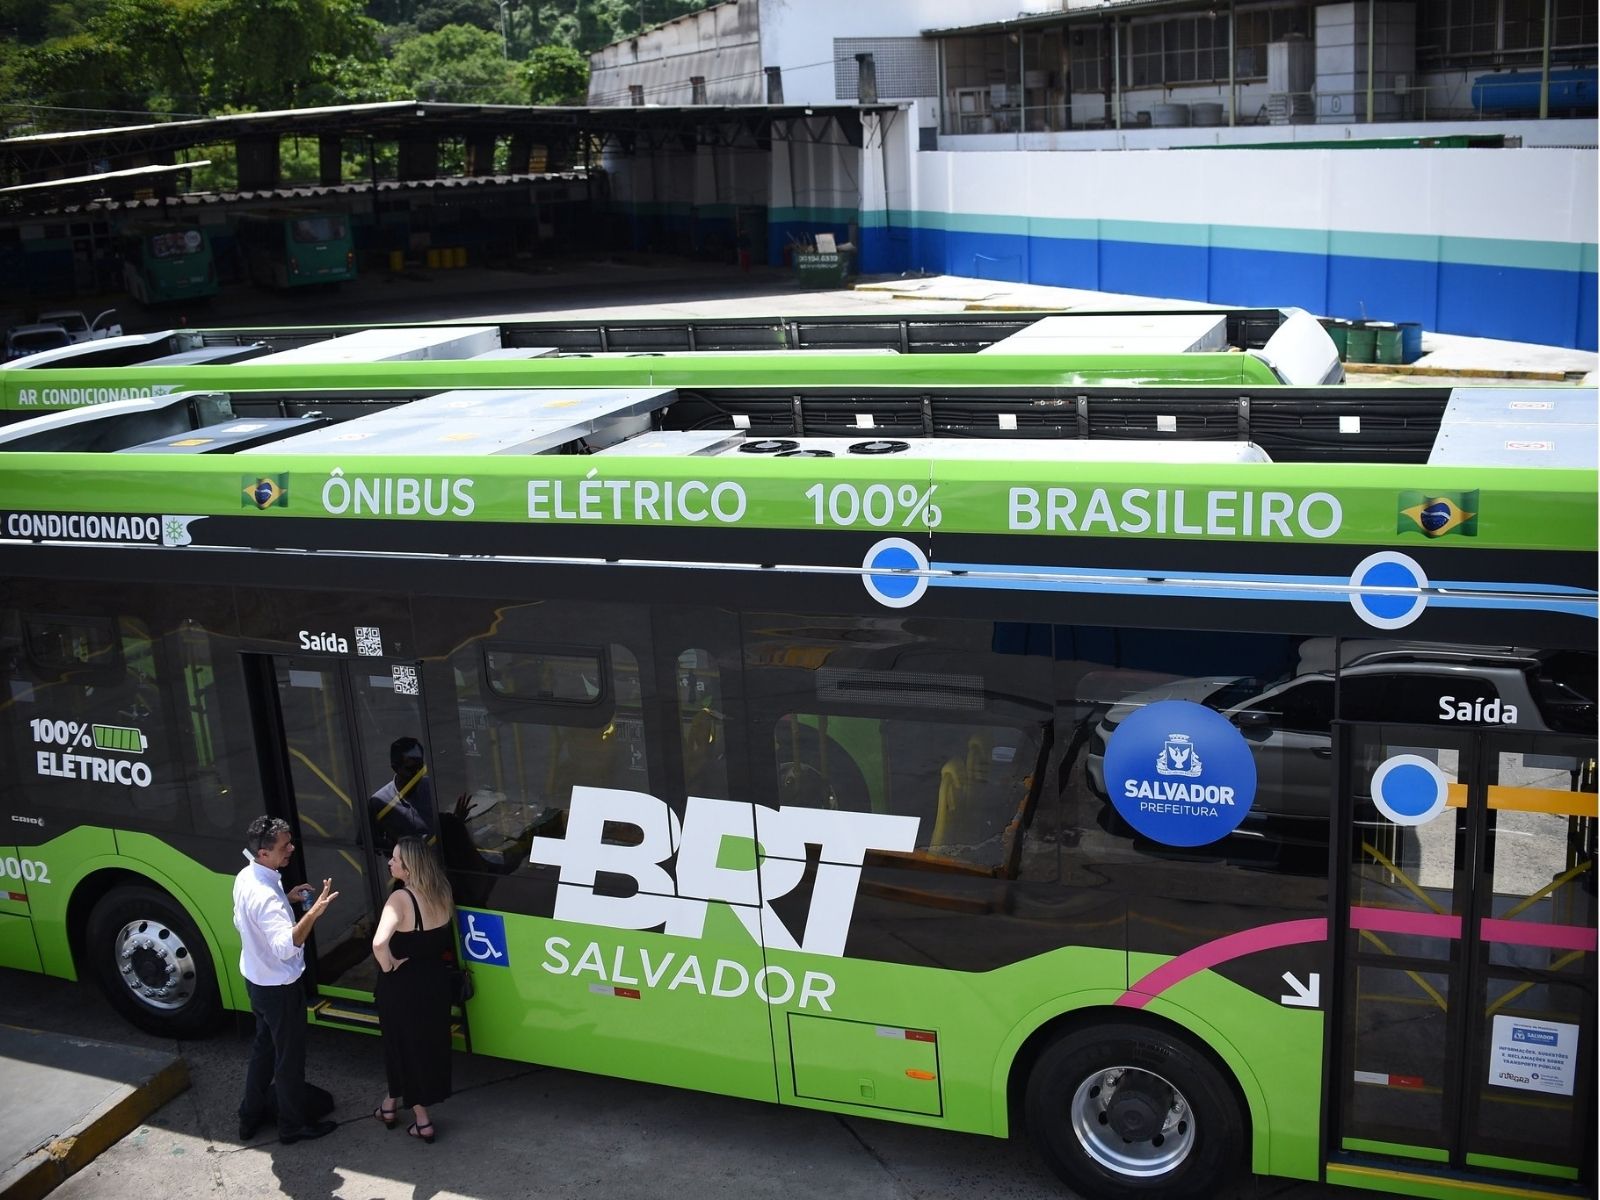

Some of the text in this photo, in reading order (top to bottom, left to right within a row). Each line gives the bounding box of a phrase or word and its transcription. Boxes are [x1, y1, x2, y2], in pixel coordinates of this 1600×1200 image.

[18, 387, 151, 405] AR CONDICIONADO
[321, 466, 1343, 539] ÔNIBUS ELÉTRICO 100% BRASILEIRO
[7, 513, 160, 541] CONDICIONADO
[298, 630, 349, 654] Saída
[1439, 695, 1519, 724] Saída
[30, 718, 92, 748] 100%
[36, 747, 152, 788] ELÉTRICO
[1124, 778, 1235, 806] SALVADOR
[1139, 801, 1219, 818] PREFEITURA
[528, 785, 921, 958] BRT
[541, 936, 837, 1012] SALVADOR
[1527, 1032, 1554, 1040] SALVADOR
